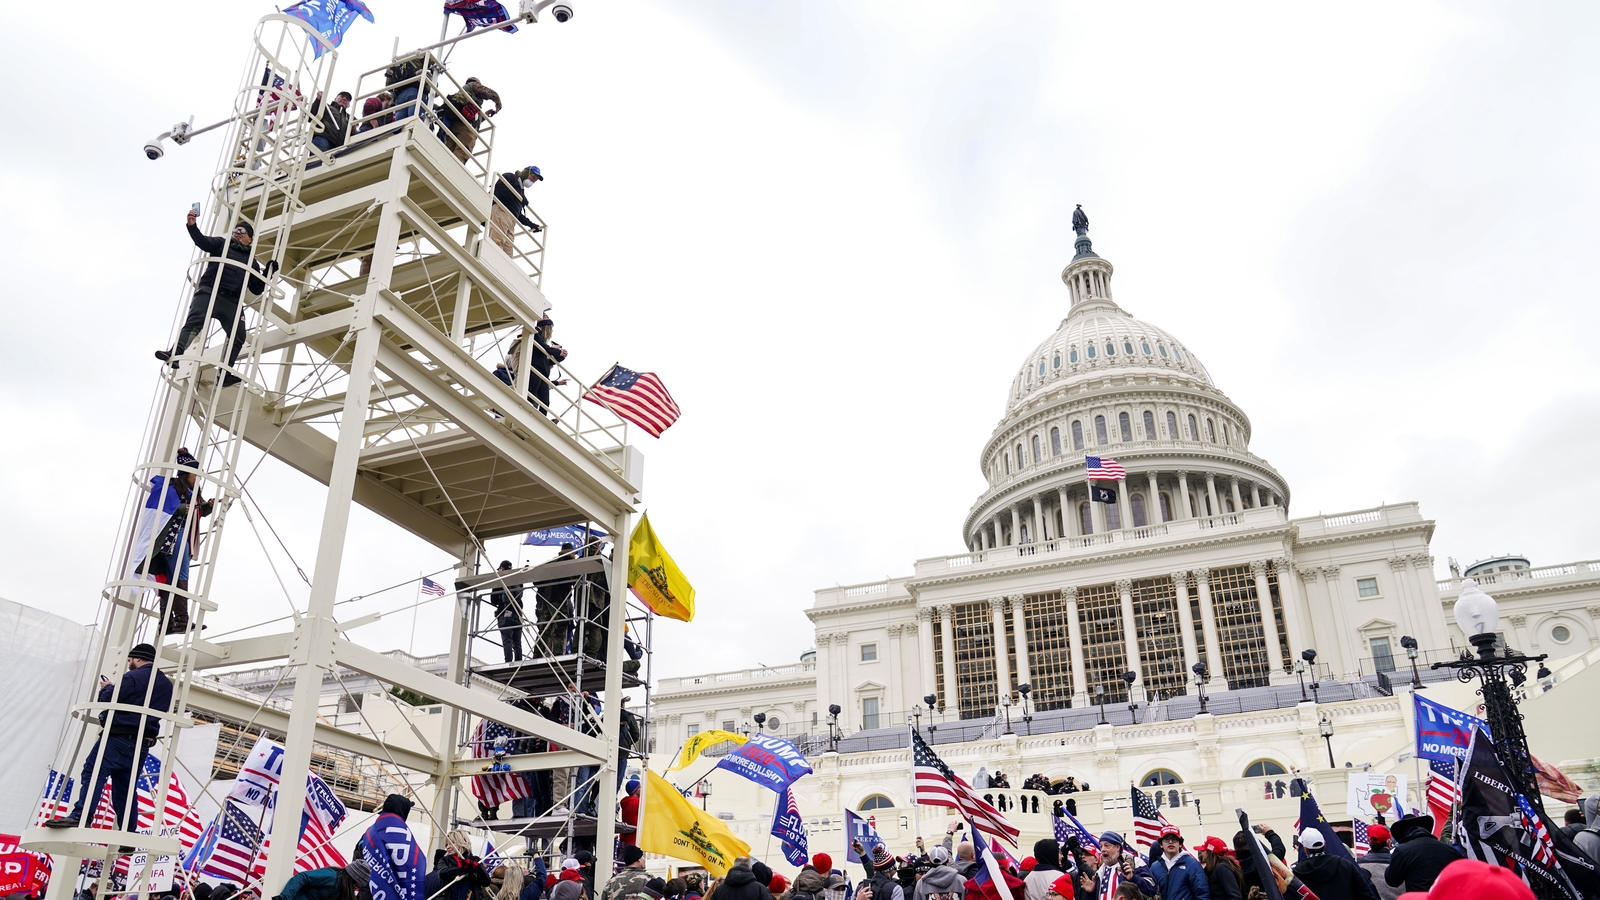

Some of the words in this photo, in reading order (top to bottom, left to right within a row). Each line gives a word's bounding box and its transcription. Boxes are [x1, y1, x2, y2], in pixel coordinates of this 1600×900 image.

[547, 531, 575, 541] AMERICA
[1422, 742, 1440, 753] NO
[731, 754, 749, 768] MORE
[747, 761, 784, 784] BULLSHIT
[245, 787, 261, 801] NO
[314, 782, 341, 816] TRUMP
[673, 836, 690, 848] DONT
[691, 843, 707, 859] TREAD
[707, 855, 718, 865] ON
[1493, 842, 1509, 857] 2nd
[1508, 850, 1559, 886] AMENDMENT
